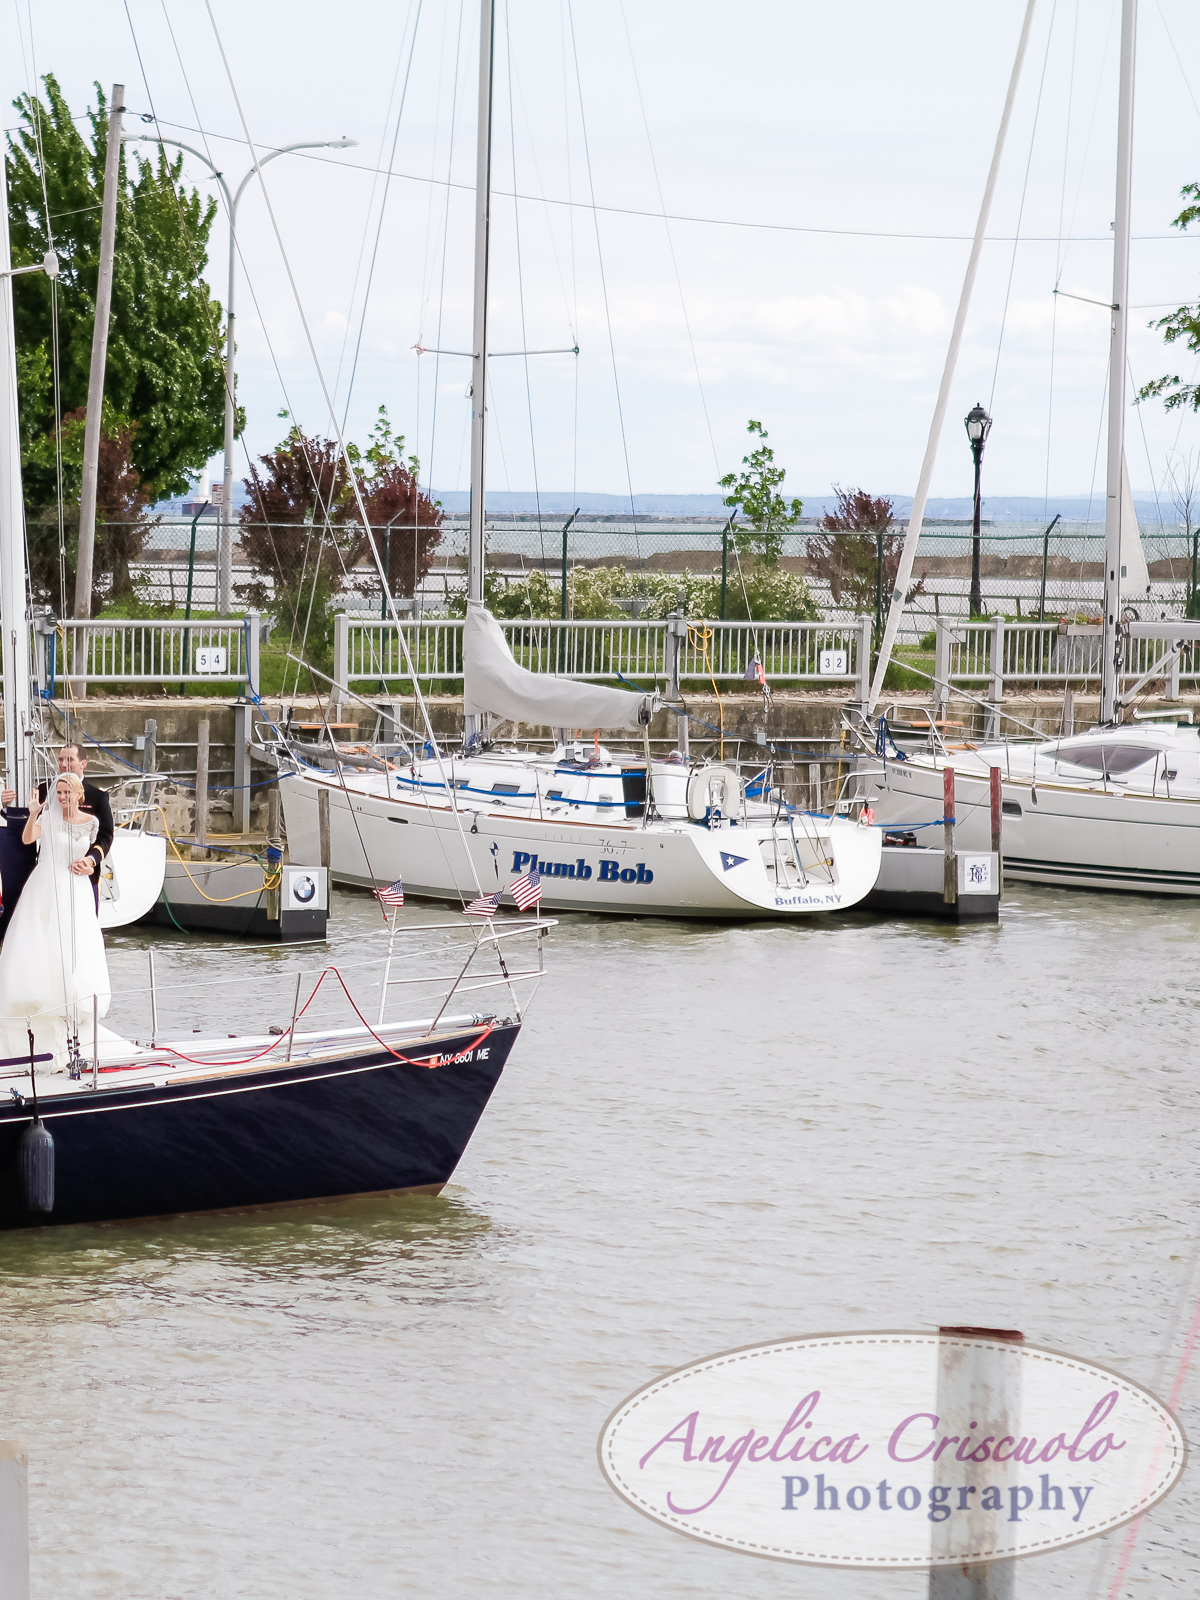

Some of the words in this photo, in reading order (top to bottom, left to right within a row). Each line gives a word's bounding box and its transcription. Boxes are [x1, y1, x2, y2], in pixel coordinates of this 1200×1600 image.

[544, 832, 582, 844] FIRST
[598, 838, 628, 856] 36.7
[511, 850, 593, 882] Plumb
[596, 859, 655, 885] Bob
[774, 895, 824, 906] Buffalo,
[825, 894, 842, 904] NY
[440, 1053, 454, 1066] NY
[476, 1047, 491, 1061] ME
